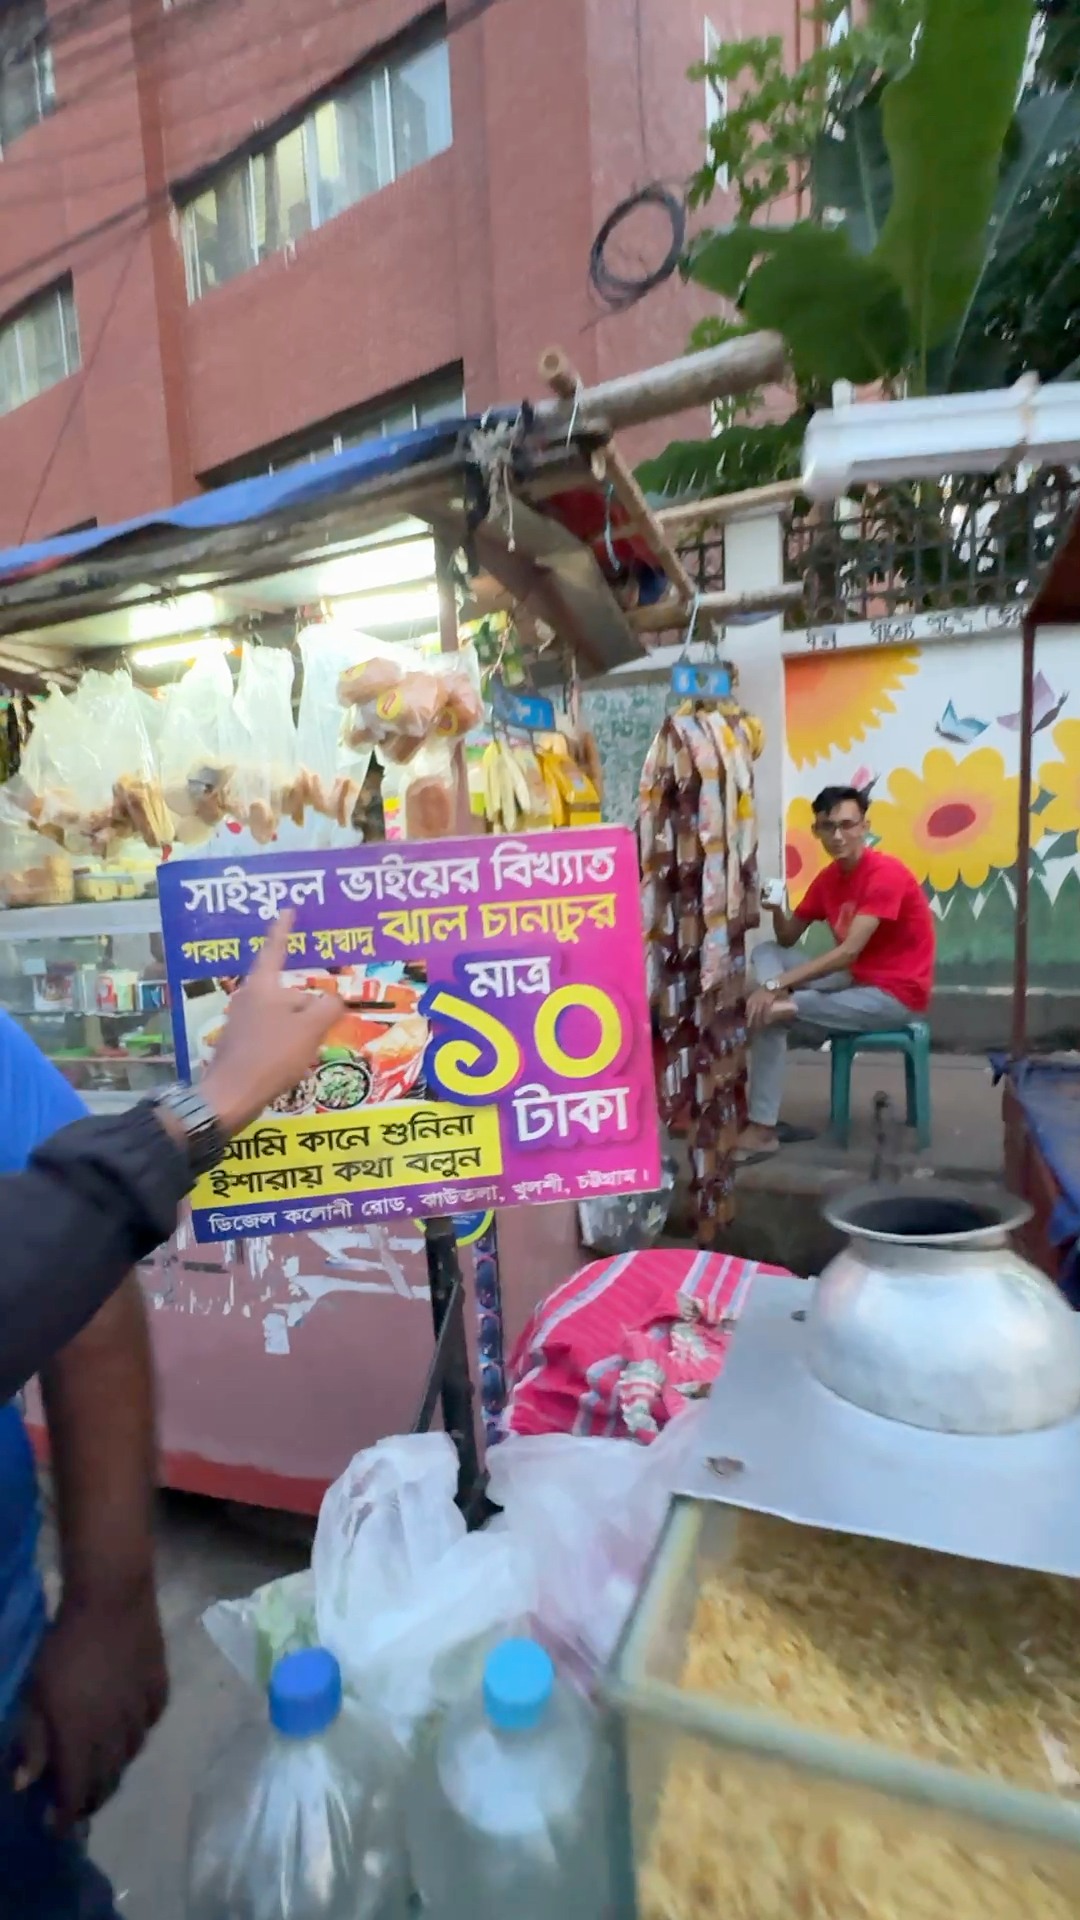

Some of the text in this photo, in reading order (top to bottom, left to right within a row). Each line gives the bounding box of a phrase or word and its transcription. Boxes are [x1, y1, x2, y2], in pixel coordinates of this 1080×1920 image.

[180, 840, 617, 921] সাইফুল ভাইয়ের বিখ্যাত
[181, 893, 617, 963] গরম গম সুস্বাদু ঝাল চানাচুর
[464, 956, 552, 998] মাত্র
[430, 983, 622, 1096] ১০
[222, 1111, 475, 1161] আমি কানে শুনিনা
[512, 1083, 630, 1142] টাকা
[209, 1147, 481, 1198] ইশারায় কথা বলুন
[208, 1211, 277, 1234] ডিজেল
[282, 1197, 353, 1225] কলোনী
